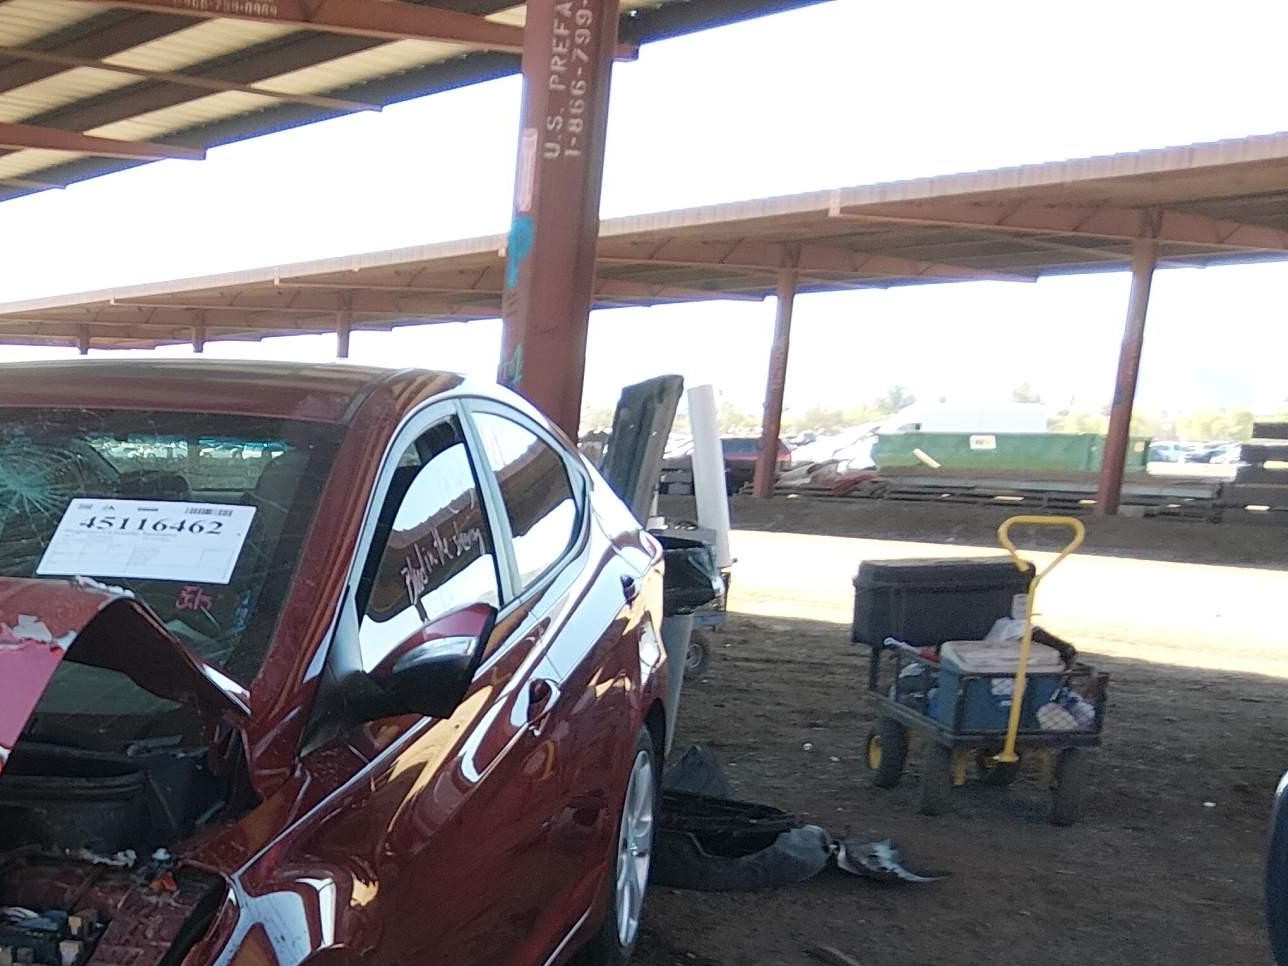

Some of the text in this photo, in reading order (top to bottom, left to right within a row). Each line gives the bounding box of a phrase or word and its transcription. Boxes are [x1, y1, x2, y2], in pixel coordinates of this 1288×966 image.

[543, 0, 573, 160] U.S. PREFA
[564, 0, 593, 157] 1-866-799-
[78, 515, 224, 536] 45116462
